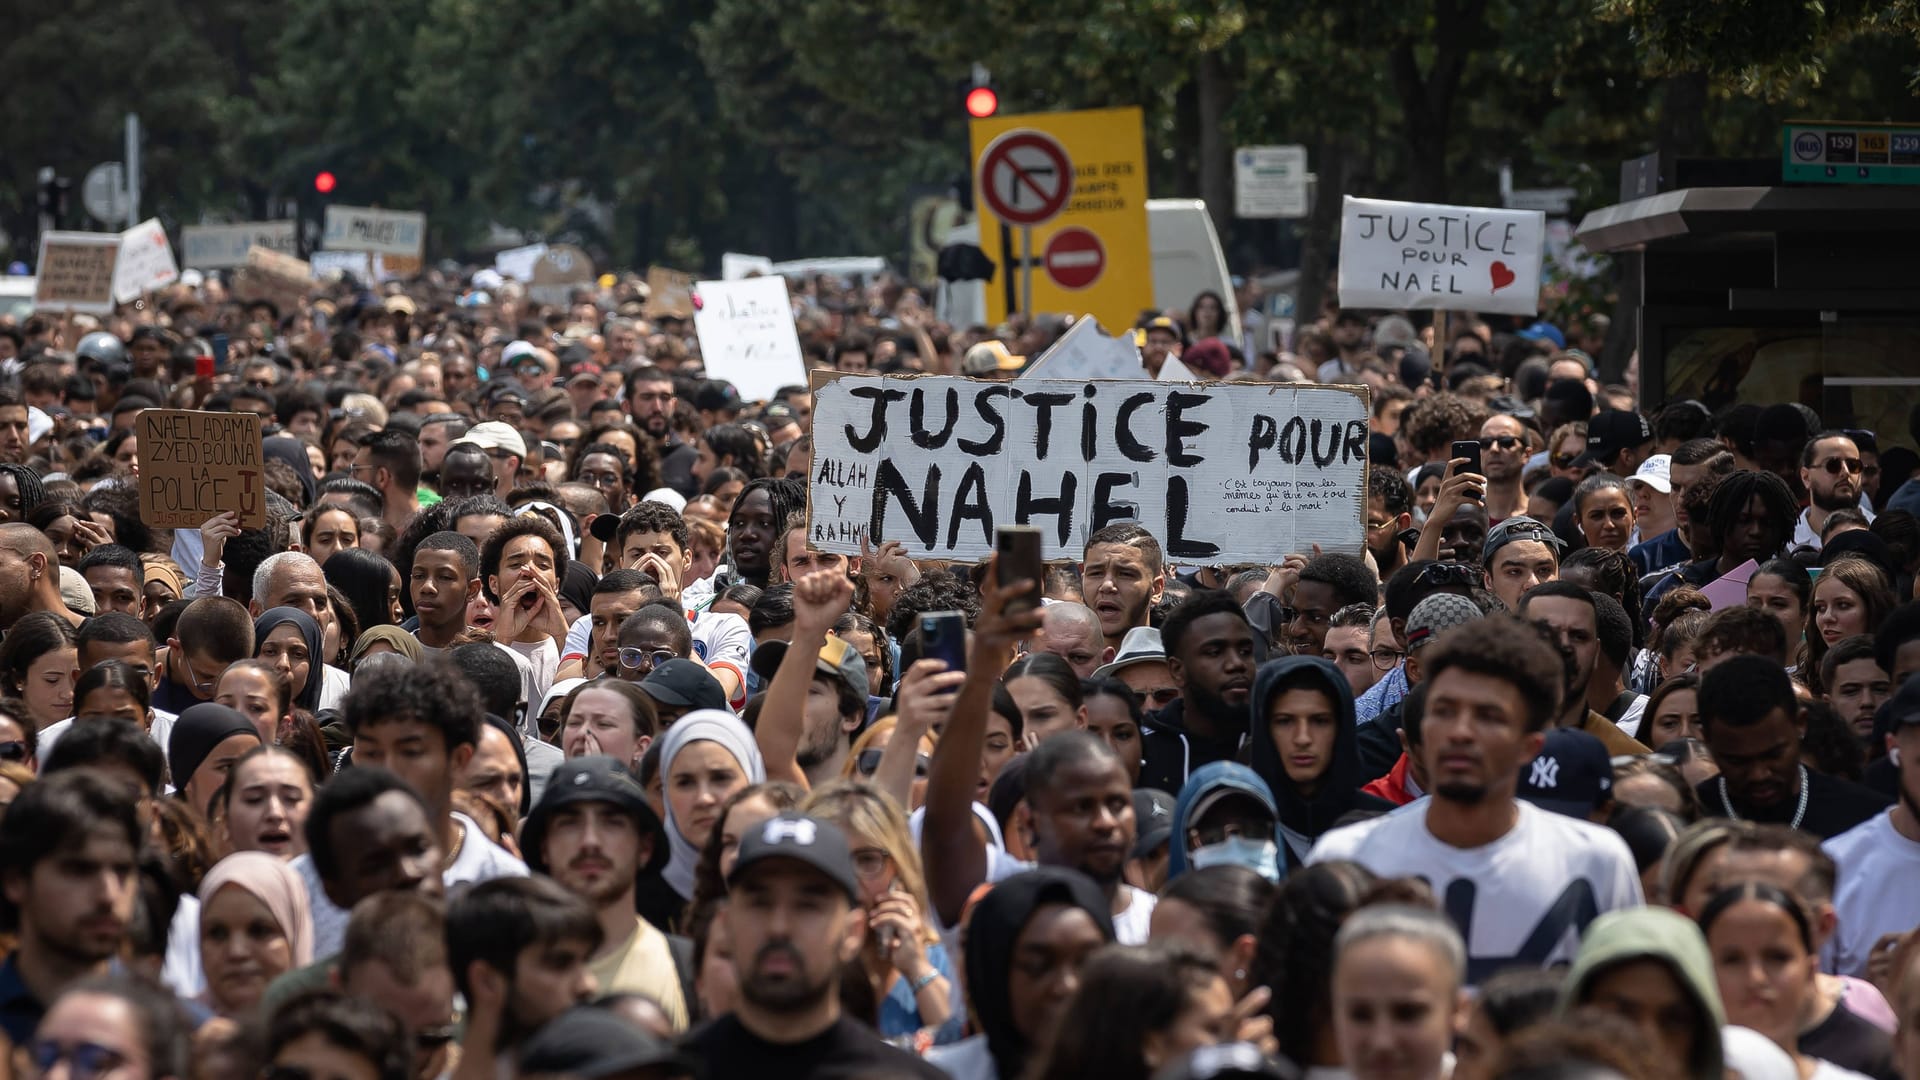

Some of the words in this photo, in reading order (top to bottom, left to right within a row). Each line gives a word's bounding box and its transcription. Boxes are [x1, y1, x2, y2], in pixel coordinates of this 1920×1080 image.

[1831, 137, 1853, 149] 159
[1863, 138, 1885, 150] 163
[1894, 137, 1918, 151] 259
[203, 416, 256, 443] ADAMA
[202, 442, 258, 466] BOUNA
[1248, 413, 1367, 474] POUR
[191, 466, 210, 481] LA
[817, 457, 868, 489] ALLAH
[832, 494, 847, 518] Y
[1225, 503, 1261, 513] conduit
